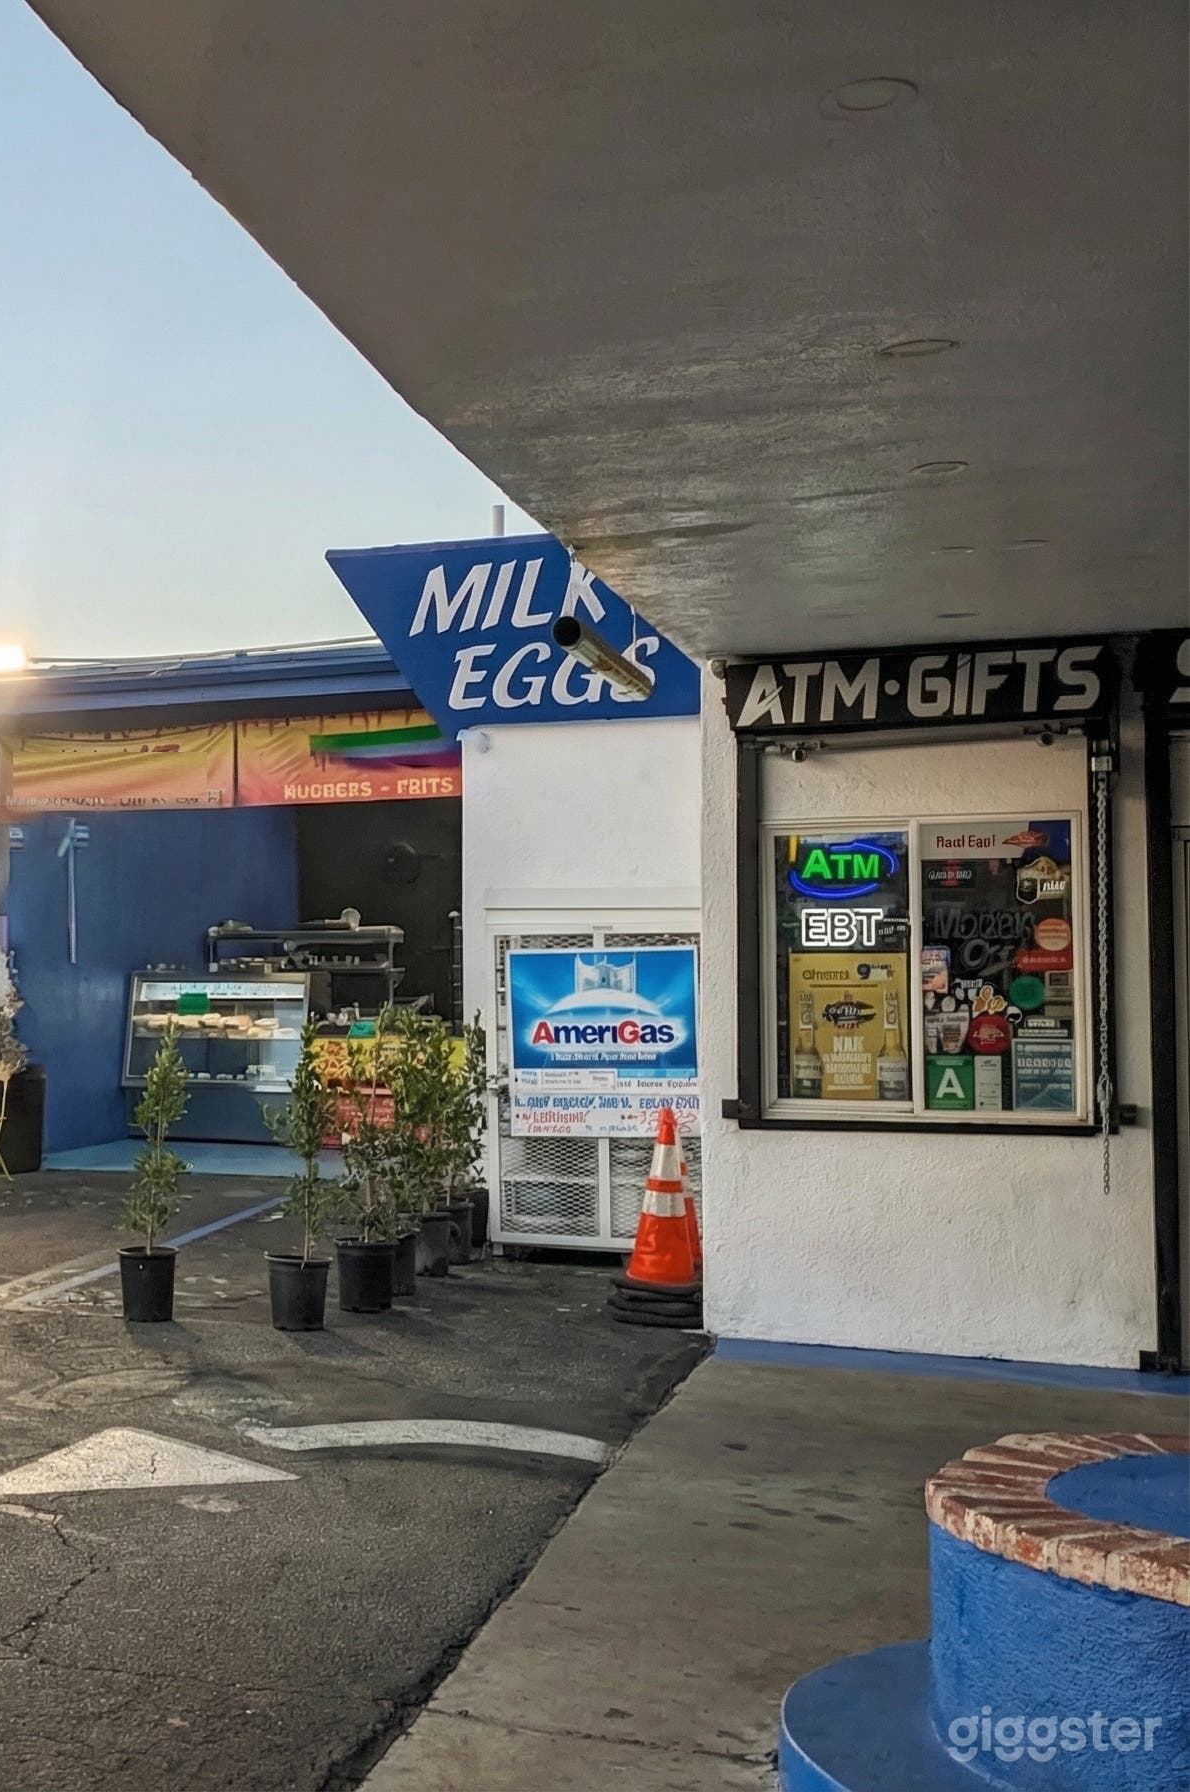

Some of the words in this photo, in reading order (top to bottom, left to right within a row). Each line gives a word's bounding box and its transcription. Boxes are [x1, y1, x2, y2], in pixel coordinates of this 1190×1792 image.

[409, 557, 606, 638] MILK
[736, 659, 880, 727] ATM
[907, 646, 1102, 717] GIFTS
[802, 848, 880, 879] ATM
[801, 908, 884, 947] EBT
[532, 1020, 674, 1045] AmeriGas
[936, 1068, 965, 1099] A
